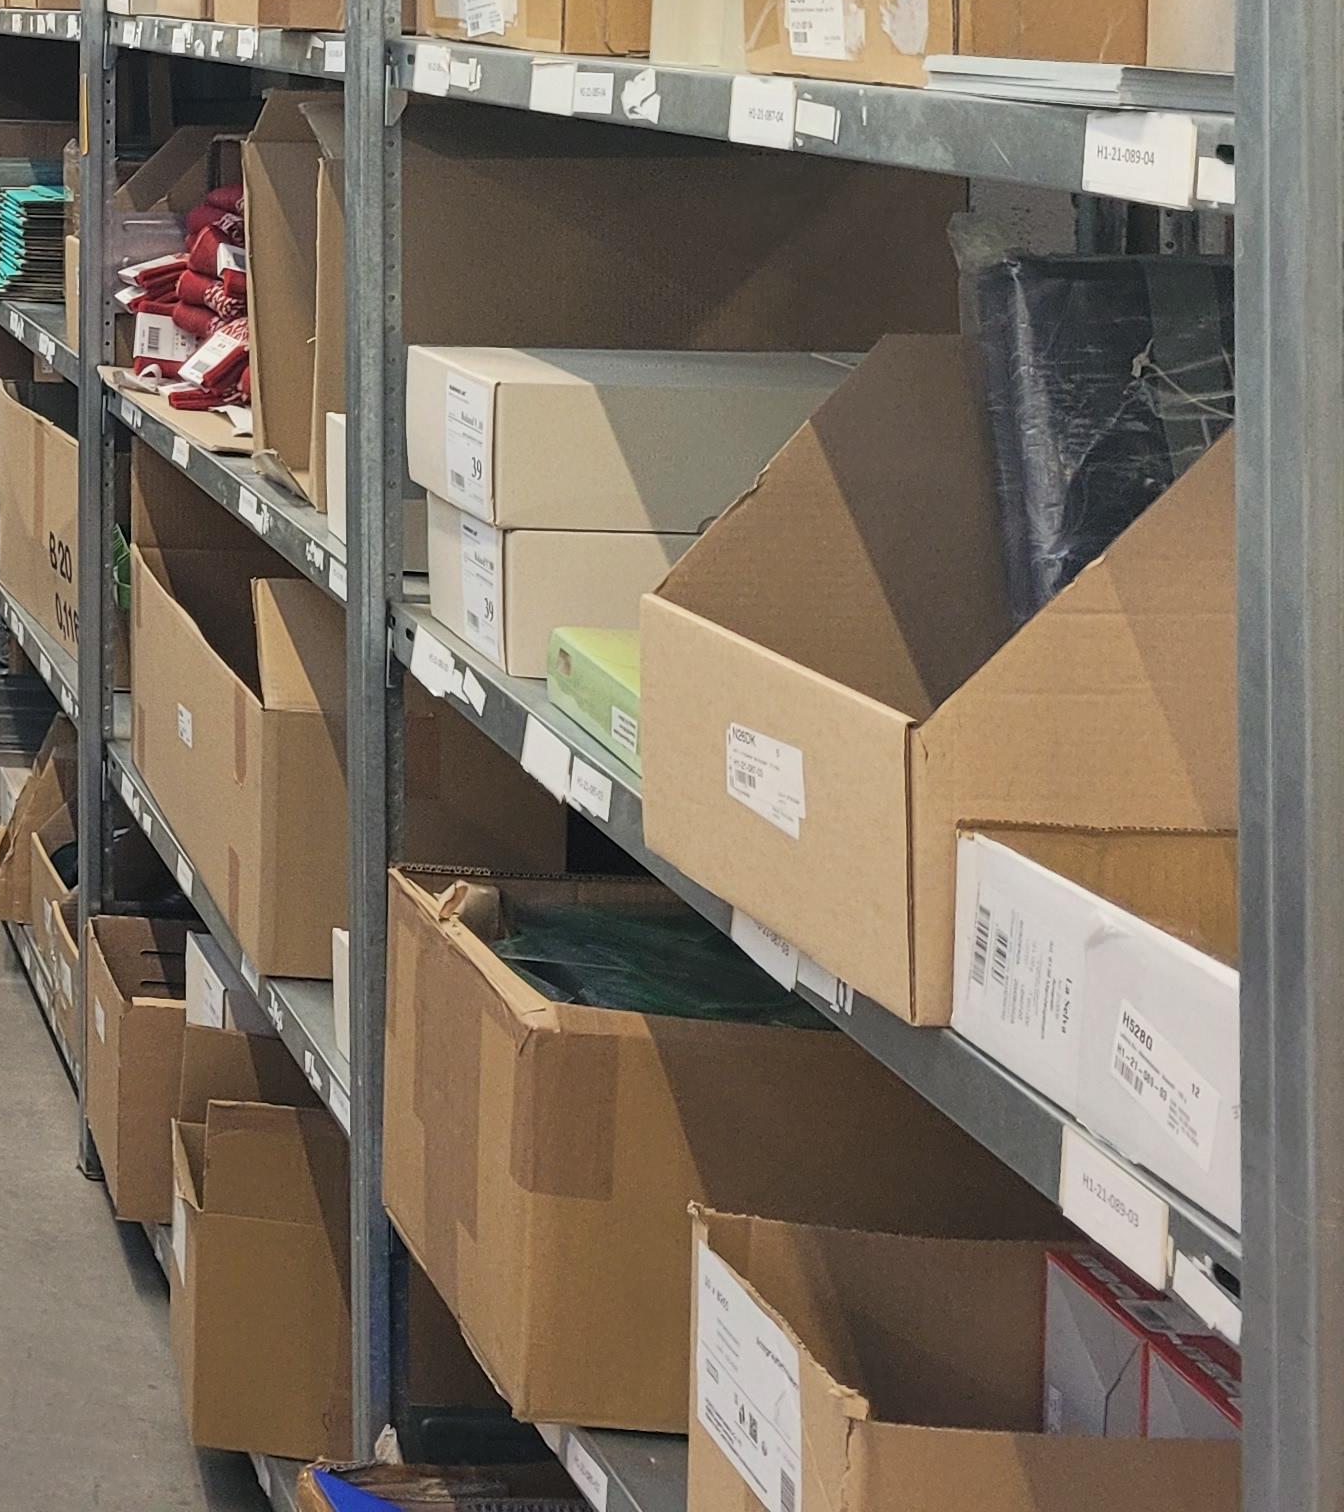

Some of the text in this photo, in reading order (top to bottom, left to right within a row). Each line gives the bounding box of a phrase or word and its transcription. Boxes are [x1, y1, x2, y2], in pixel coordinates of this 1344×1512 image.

[1096, 143, 1156, 167] H1-21-089-04
[470, 455, 483, 482] 39
[483, 596, 495, 623] 39
[1190, 1082, 1201, 1100] 12
[1081, 1172, 1141, 1229] H1-21-089-03
